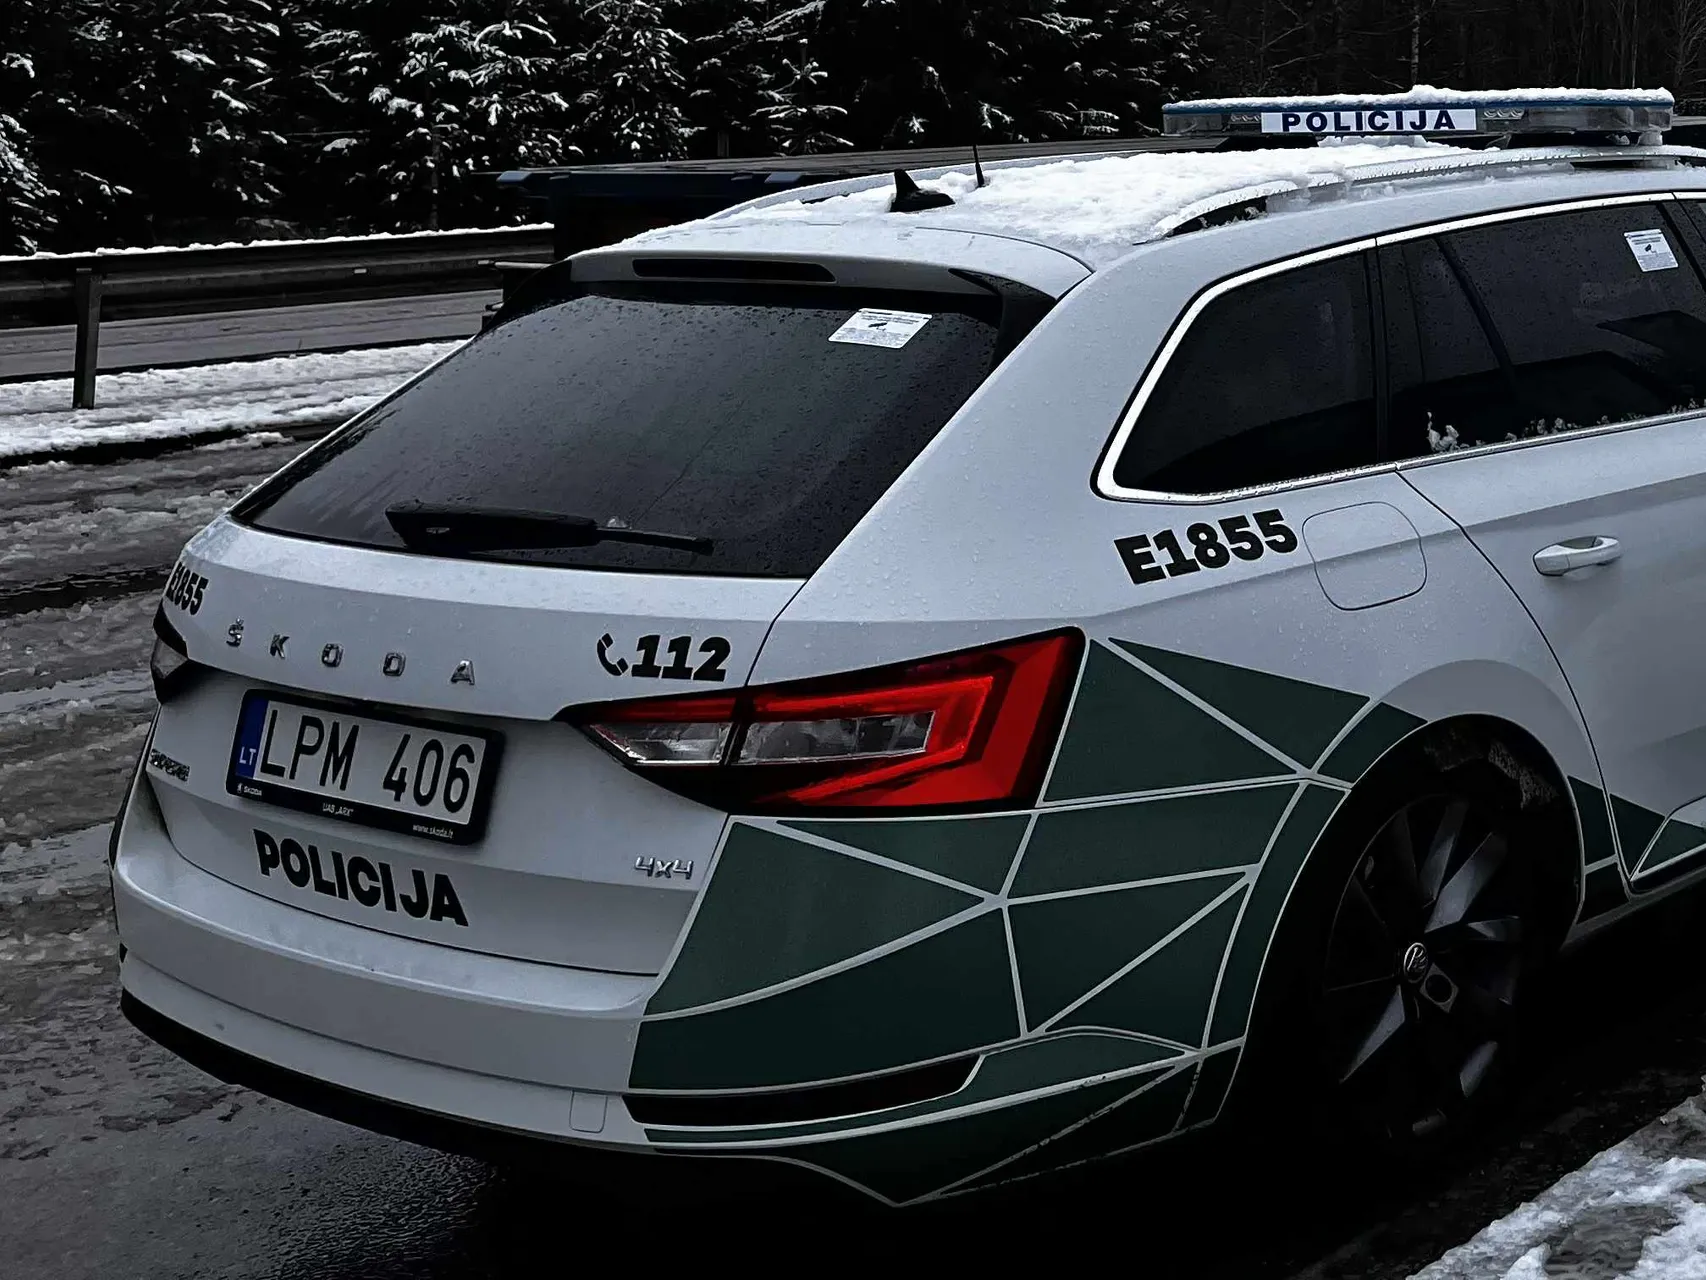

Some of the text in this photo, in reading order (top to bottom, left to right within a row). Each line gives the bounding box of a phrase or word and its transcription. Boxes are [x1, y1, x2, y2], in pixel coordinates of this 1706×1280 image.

[1281, 110, 1456, 132] POLICIJA
[1113, 509, 1299, 585] E1855
[226, 616, 476, 686] ŠKODA
[631, 634, 731, 682] 112
[239, 747, 257, 766] LT
[260, 709, 360, 791] LPM
[383, 733, 476, 814] 406
[252, 829, 469, 927] POLICIJA
